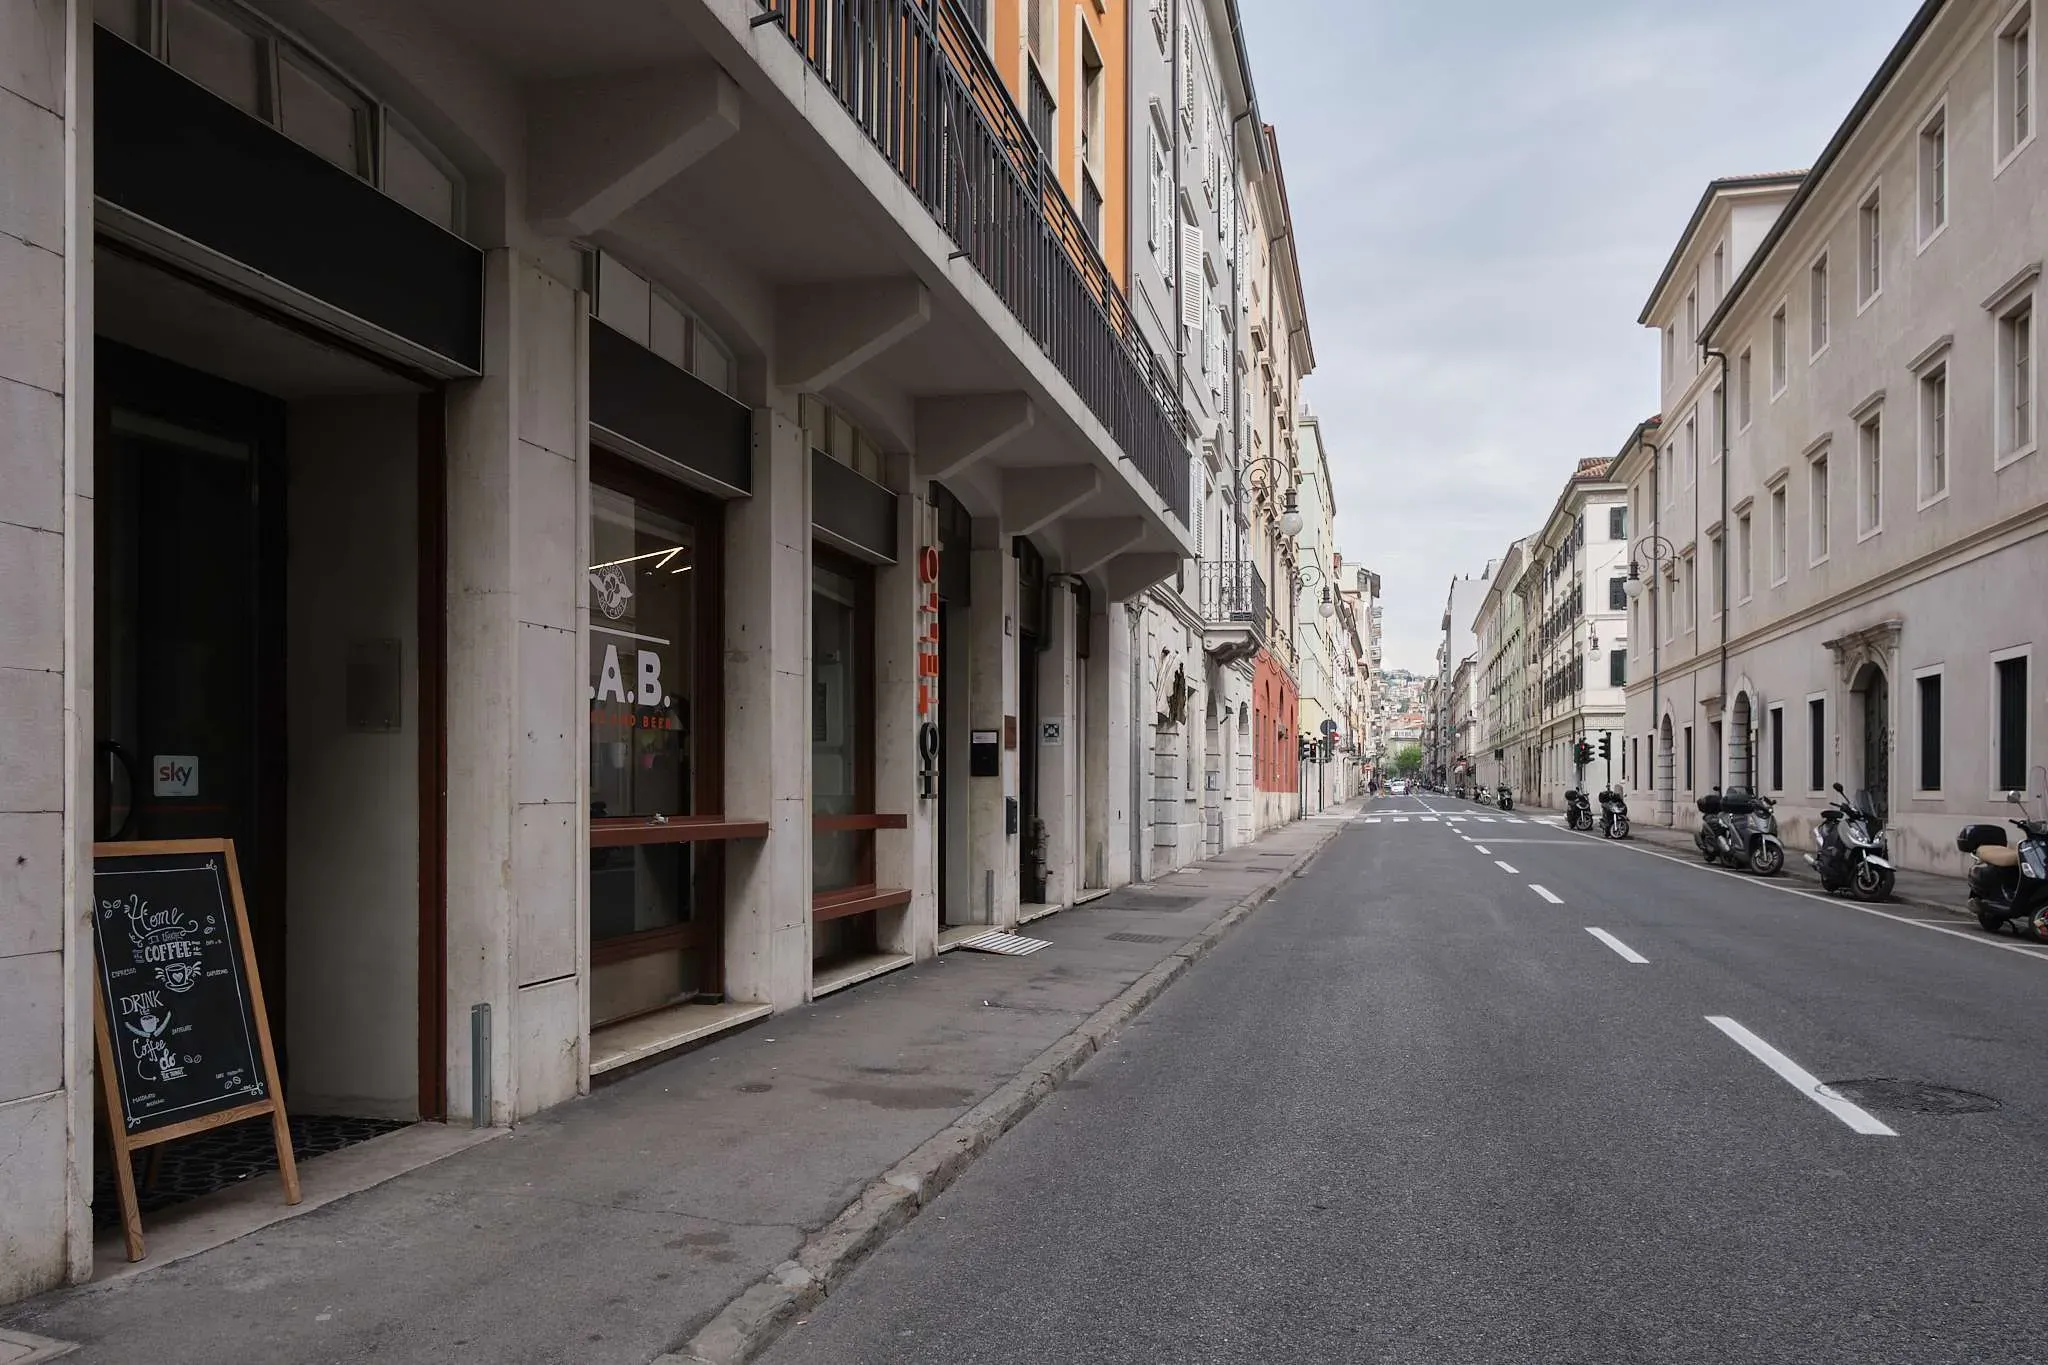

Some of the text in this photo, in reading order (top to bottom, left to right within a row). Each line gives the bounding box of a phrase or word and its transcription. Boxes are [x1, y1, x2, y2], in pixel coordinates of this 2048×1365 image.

[160, 761, 193, 787] sky
[144, 941, 192, 962] COFFEE
[120, 990, 164, 1015] DRINK
[132, 1038, 167, 1062] Coffee
[160, 1048, 176, 1070] do
